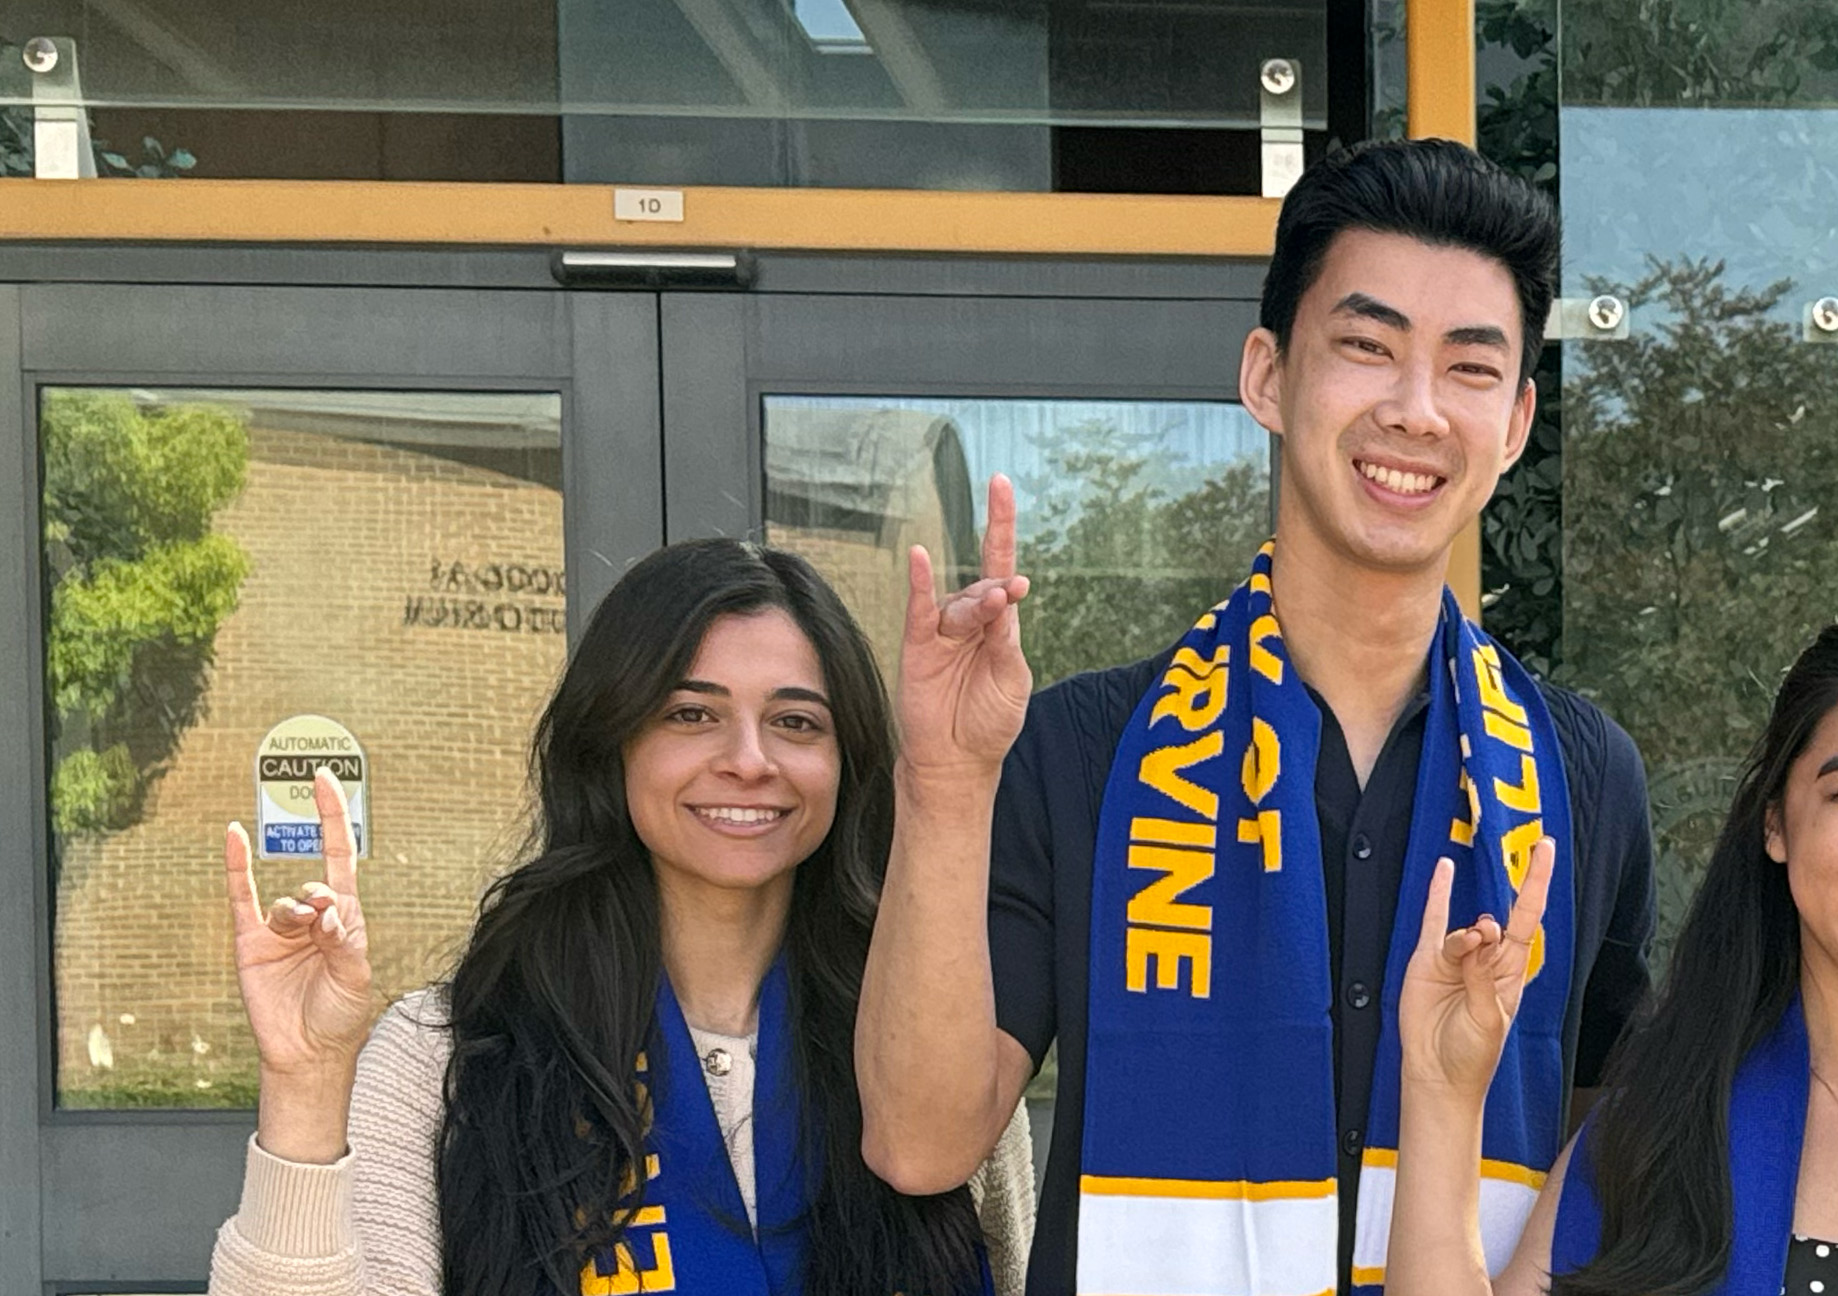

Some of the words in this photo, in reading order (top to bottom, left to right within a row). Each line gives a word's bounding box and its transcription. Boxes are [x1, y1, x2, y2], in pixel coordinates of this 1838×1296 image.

[638, 197, 662, 214] 1D
[269, 736, 351, 751] AUTOMATIC
[289, 785, 315, 800] DO
[266, 825, 318, 838] ACTIVATE
[281, 839, 295, 852] TO
